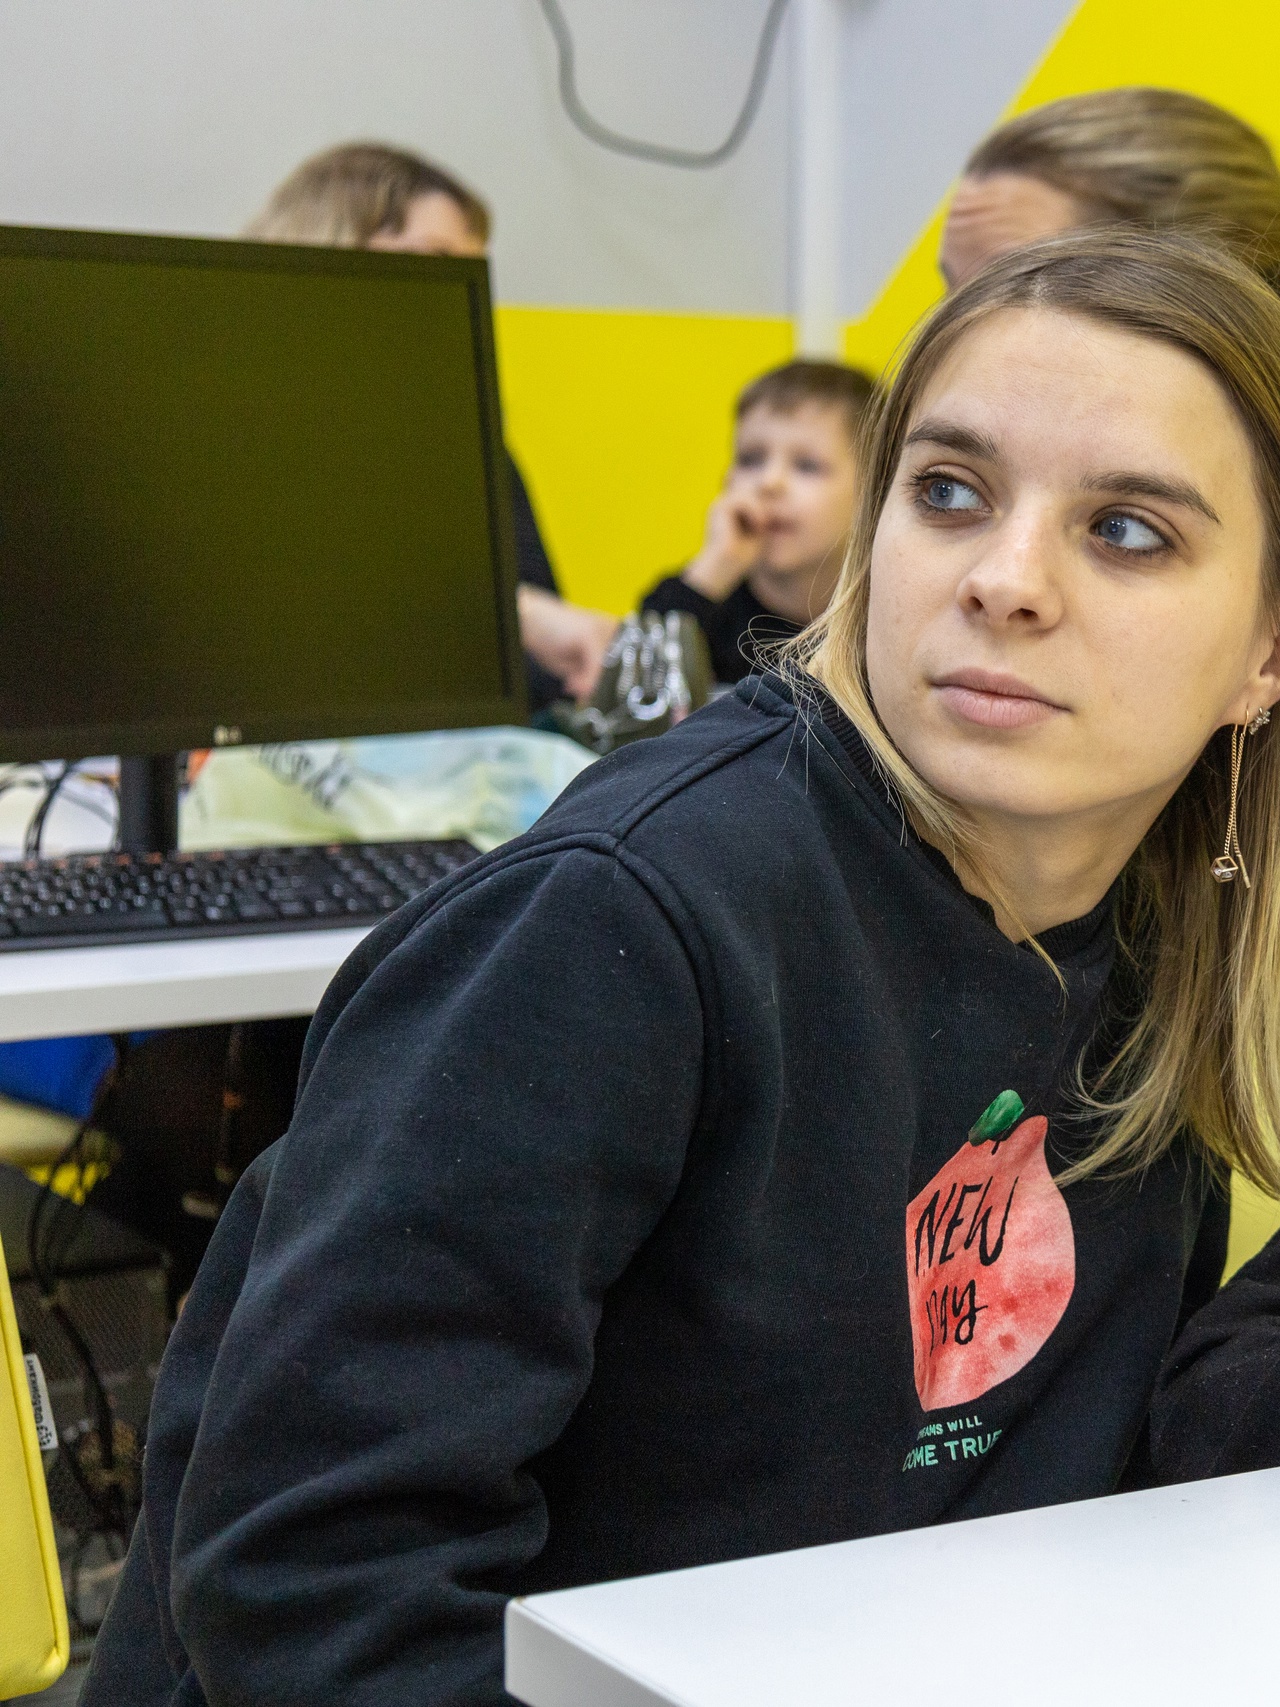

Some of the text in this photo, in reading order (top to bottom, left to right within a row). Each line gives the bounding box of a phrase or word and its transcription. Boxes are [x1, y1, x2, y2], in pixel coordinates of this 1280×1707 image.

[915, 1176, 1019, 1276] NEW
[946, 1415, 983, 1432] WILL
[943, 1429, 1002, 1461] TRUE
